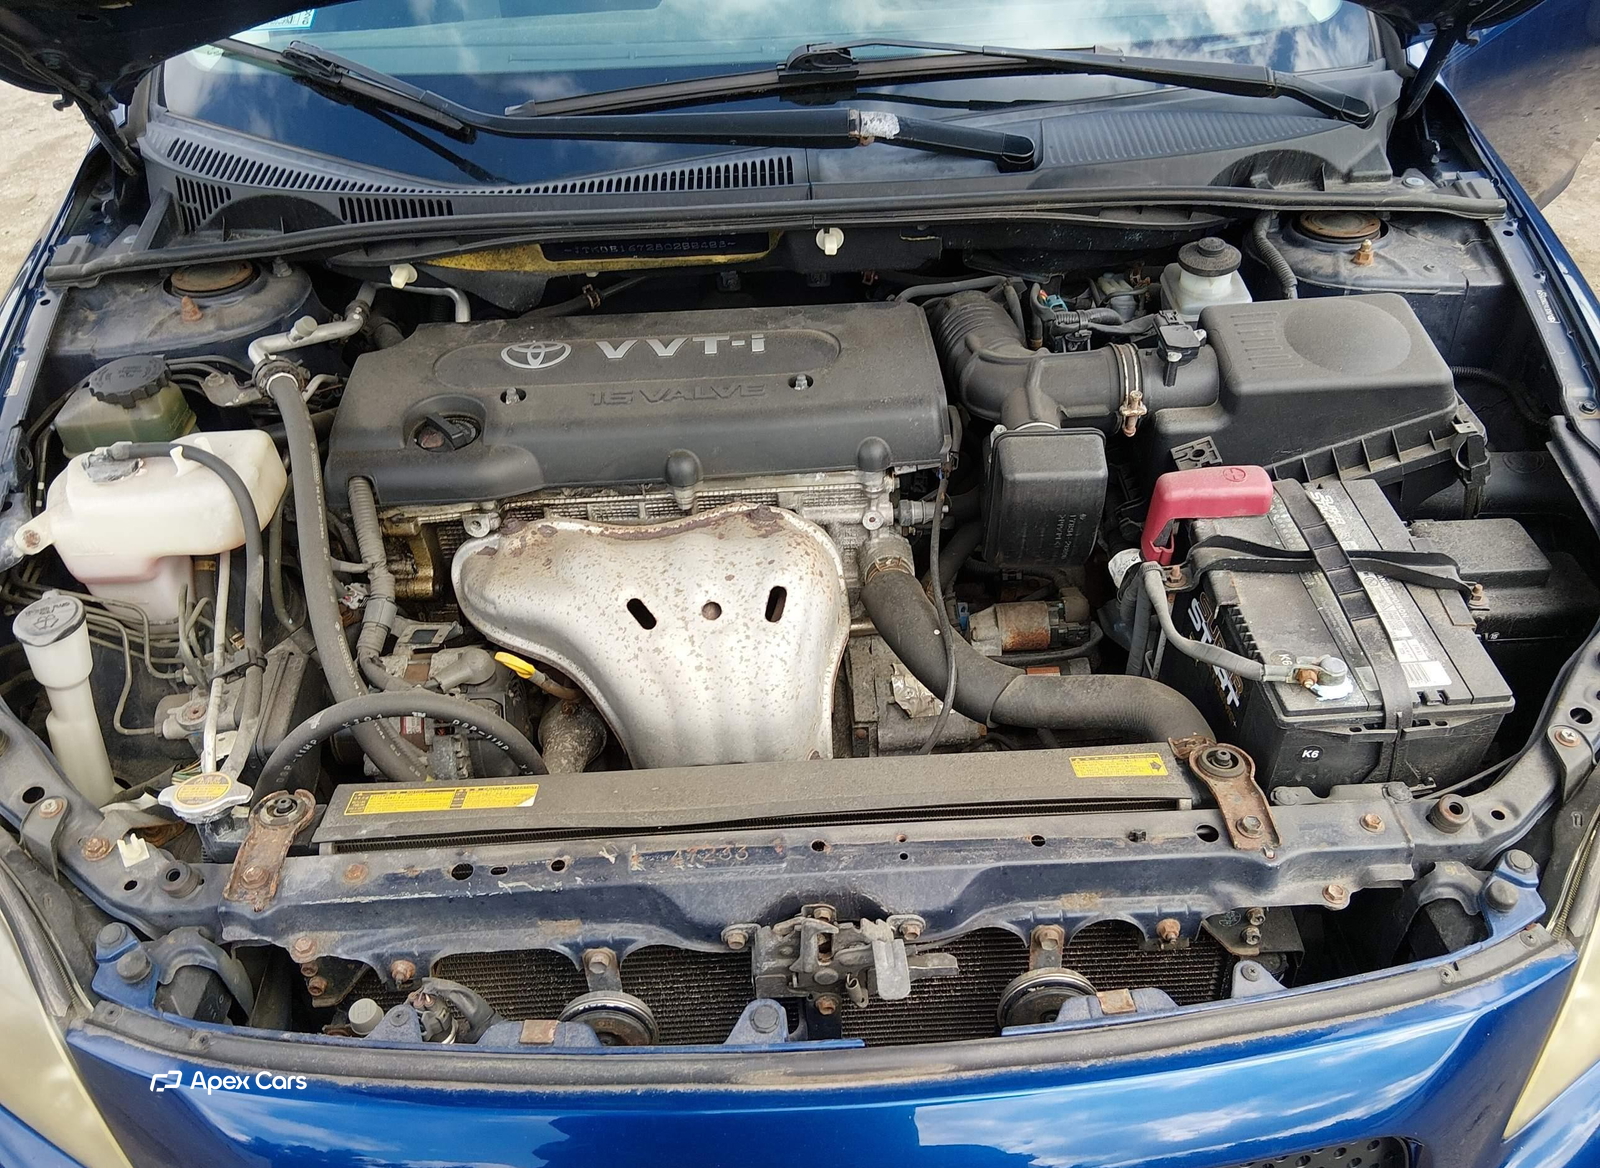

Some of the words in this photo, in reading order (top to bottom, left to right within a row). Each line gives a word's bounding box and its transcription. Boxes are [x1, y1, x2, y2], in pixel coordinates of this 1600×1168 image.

[595, 334, 766, 359] VVT-i
[639, 383, 766, 404] VALVE
[1301, 748, 1320, 759] K6
